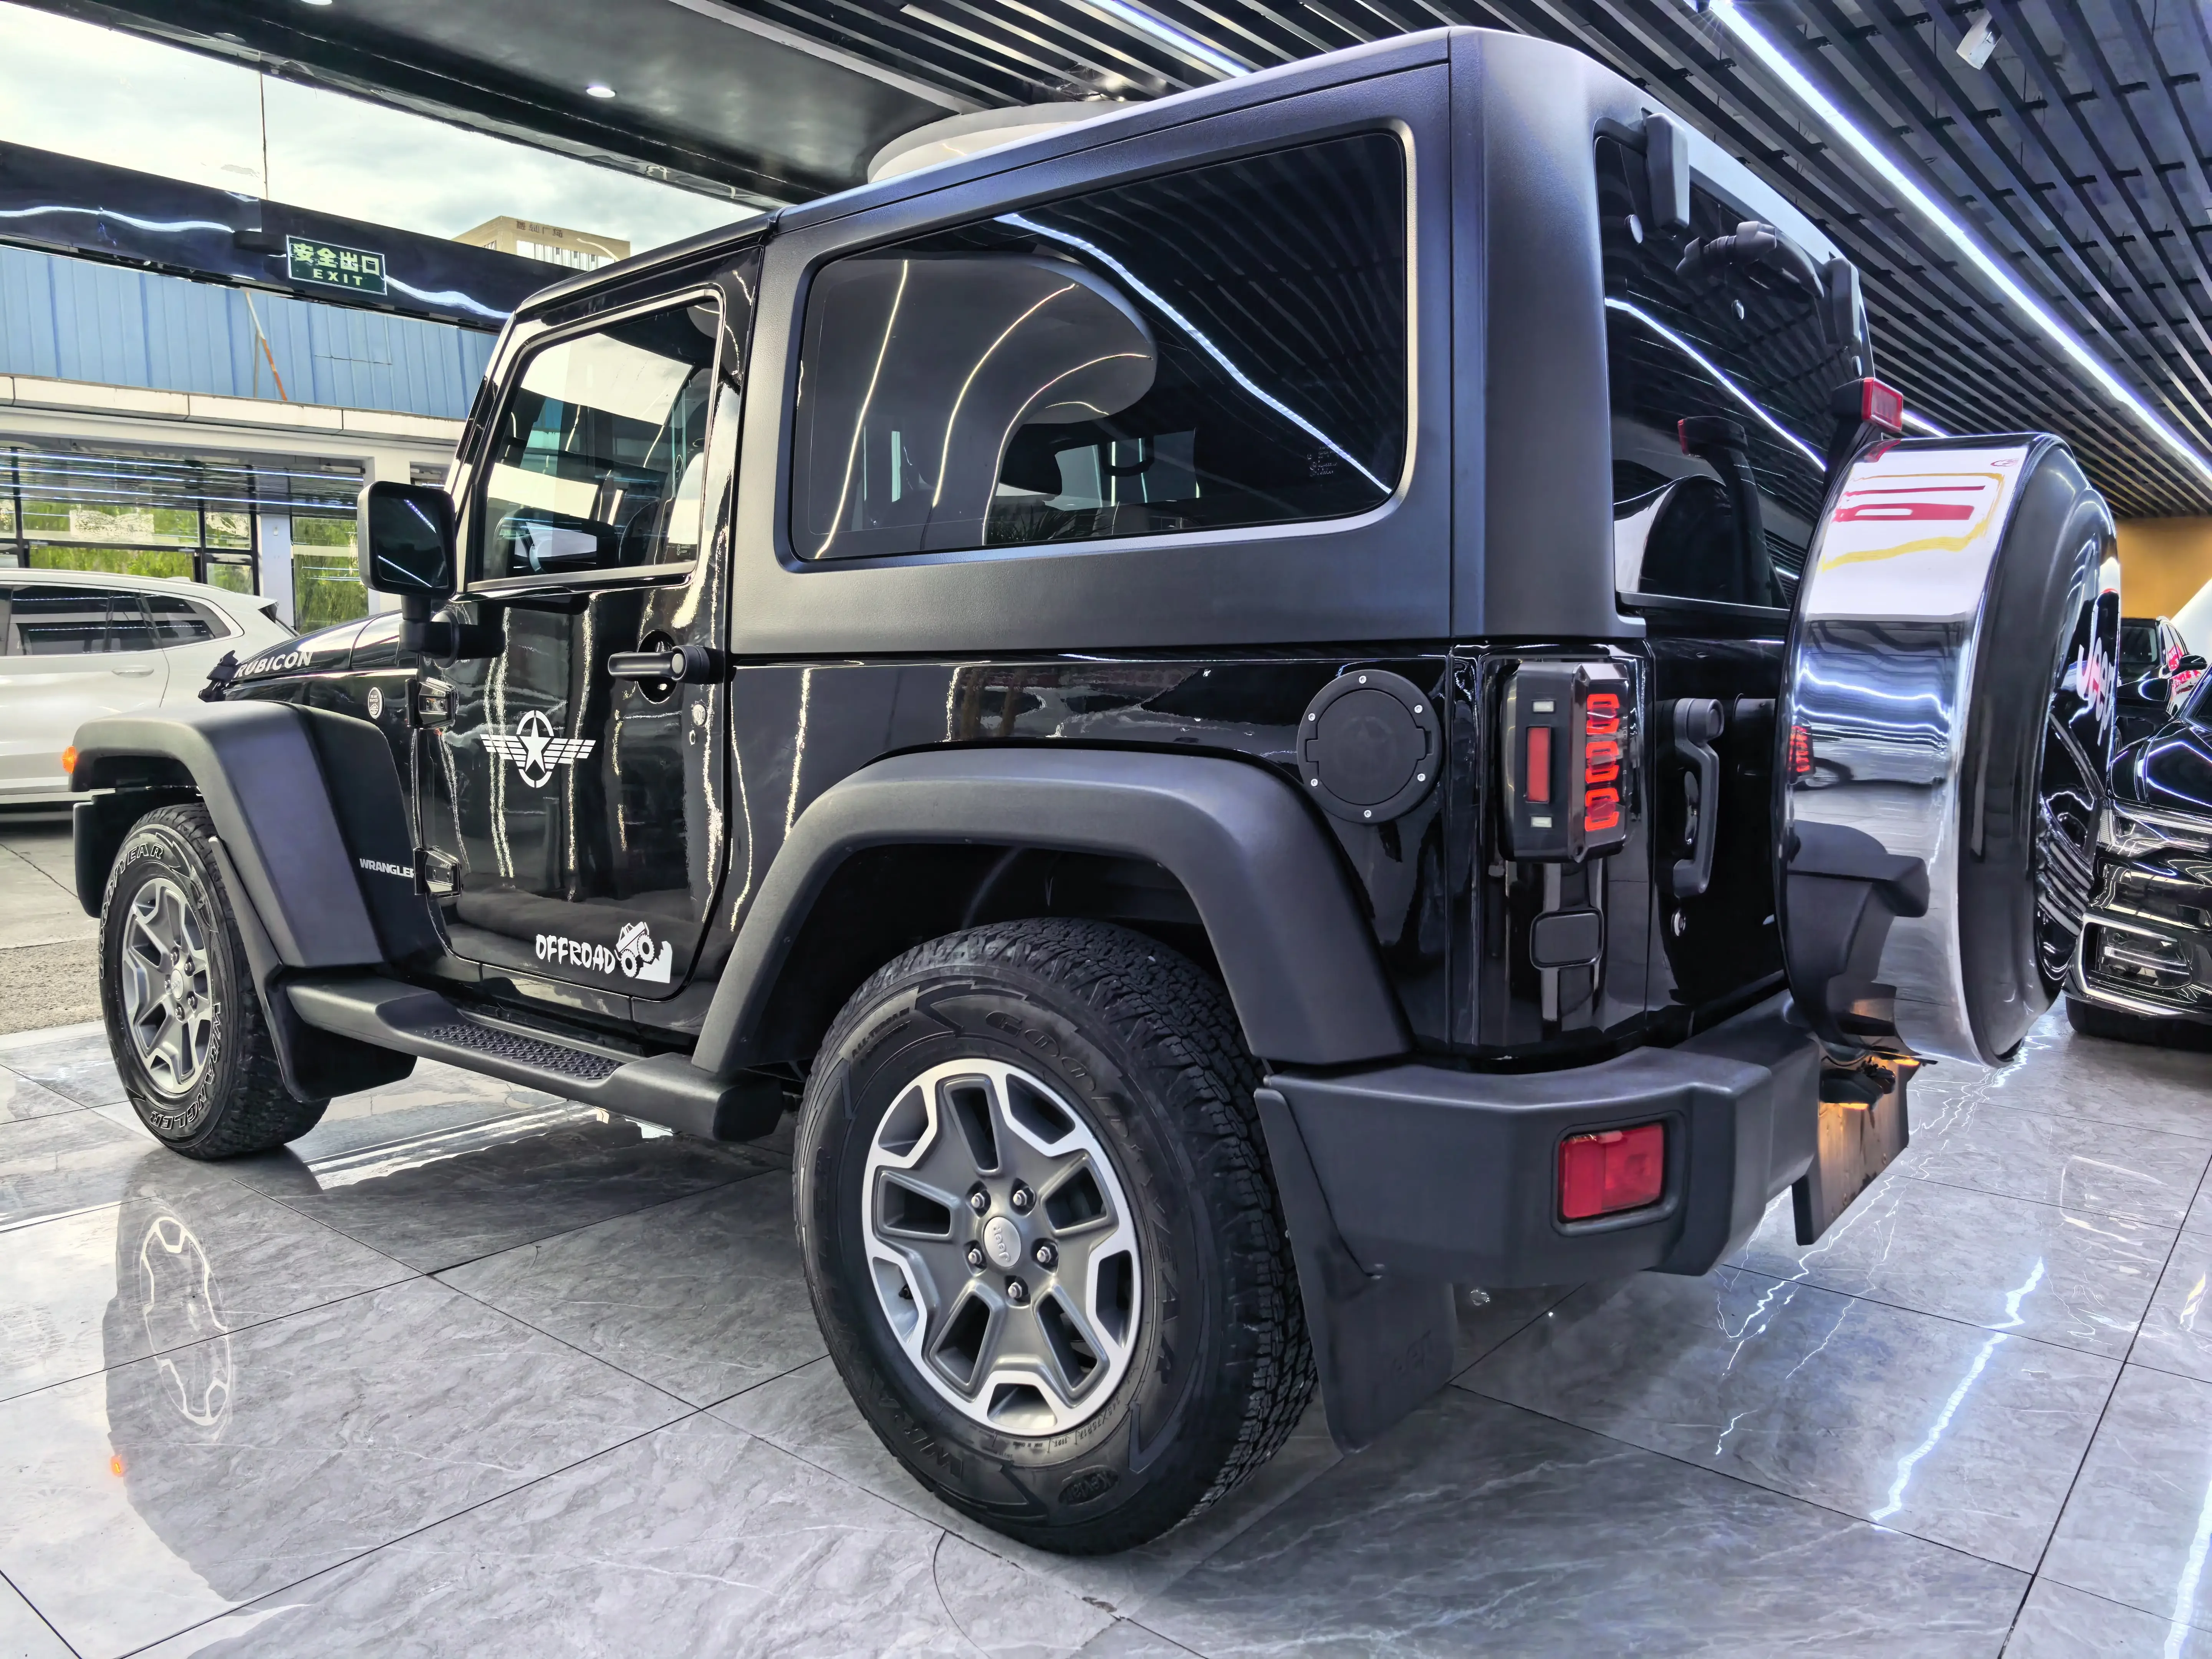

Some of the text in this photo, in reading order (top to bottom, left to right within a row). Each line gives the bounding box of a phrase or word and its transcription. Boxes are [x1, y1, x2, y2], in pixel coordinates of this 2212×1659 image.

[293, 243, 379, 276] 安全出口
[313, 268, 363, 285] EXIT
[233, 652, 313, 678] RUBICON
[99, 843, 164, 979] GOODYEAR
[536, 934, 616, 974] OFFROAD
[150, 1002, 221, 1130] WRANGLER
[993, 1225, 1010, 1262] Jeep
